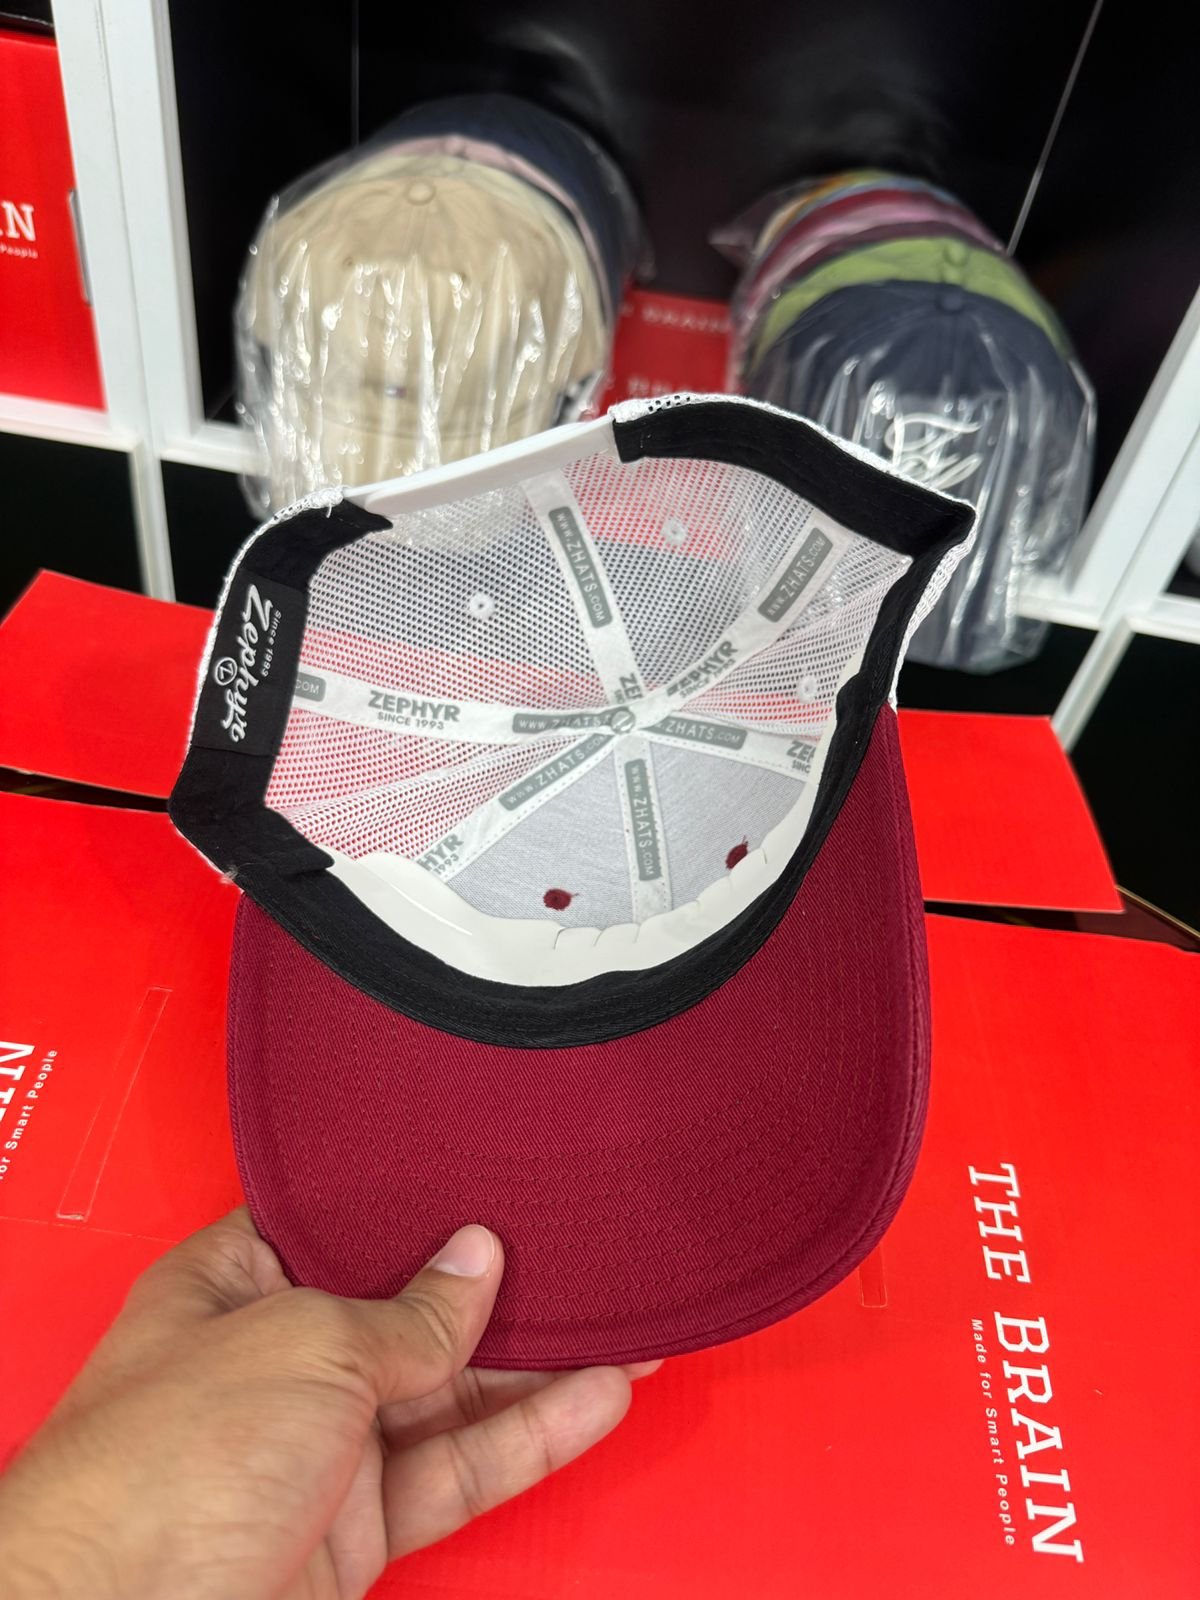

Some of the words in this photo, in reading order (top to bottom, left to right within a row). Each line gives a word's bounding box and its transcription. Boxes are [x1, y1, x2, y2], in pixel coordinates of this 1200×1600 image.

[221, 584, 274, 743] Zephyr
[368, 689, 461, 722] ZEPHYR
[377, 712, 411, 727] SINCE
[416, 718, 445, 731] 1993
[5, 1106, 34, 1150] Smart
[26, 1050, 58, 1099] People
[968, 1162, 1032, 1284] THE
[971, 1318, 987, 1364] Made
[980, 1371, 993, 1399] for
[985, 1407, 1004, 1465] Smart
[993, 1311, 1084, 1563] BRAIN
[995, 1473, 1016, 1546] People
